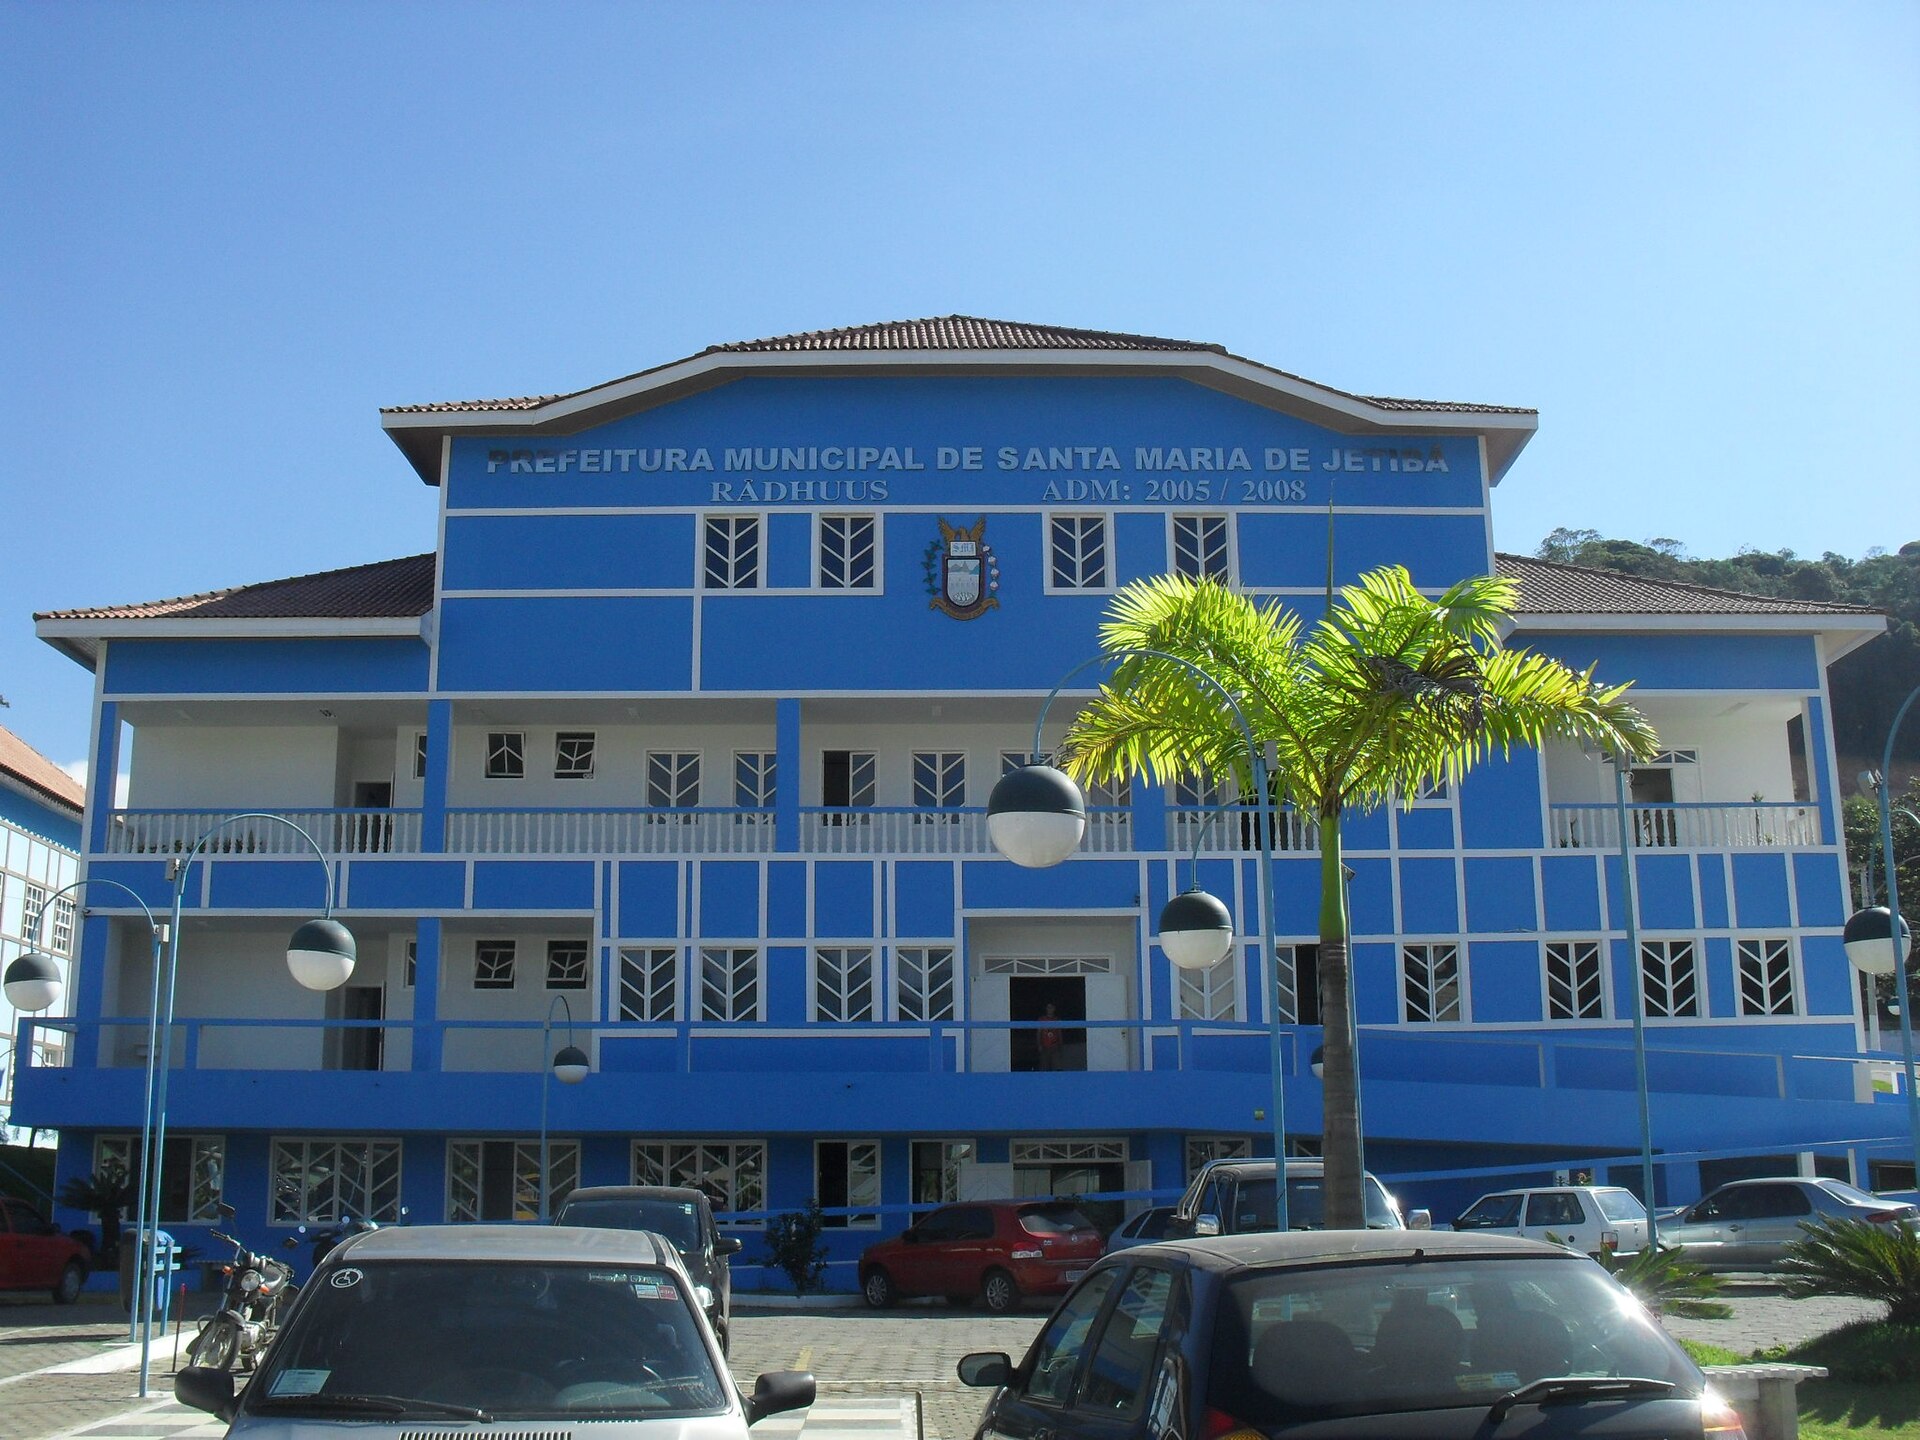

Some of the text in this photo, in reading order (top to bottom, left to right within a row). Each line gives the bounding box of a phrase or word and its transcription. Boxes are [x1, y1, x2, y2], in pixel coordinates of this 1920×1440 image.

[487, 449, 713, 473] PREFEITURA
[724, 447, 924, 471] MUNICIPAL
[937, 447, 983, 470] DE
[997, 447, 1121, 470] SANTA
[1135, 447, 1251, 471] MARIA
[1264, 448, 1311, 471] DE
[1042, 479, 1307, 502] ADM: 2005 / 2008
